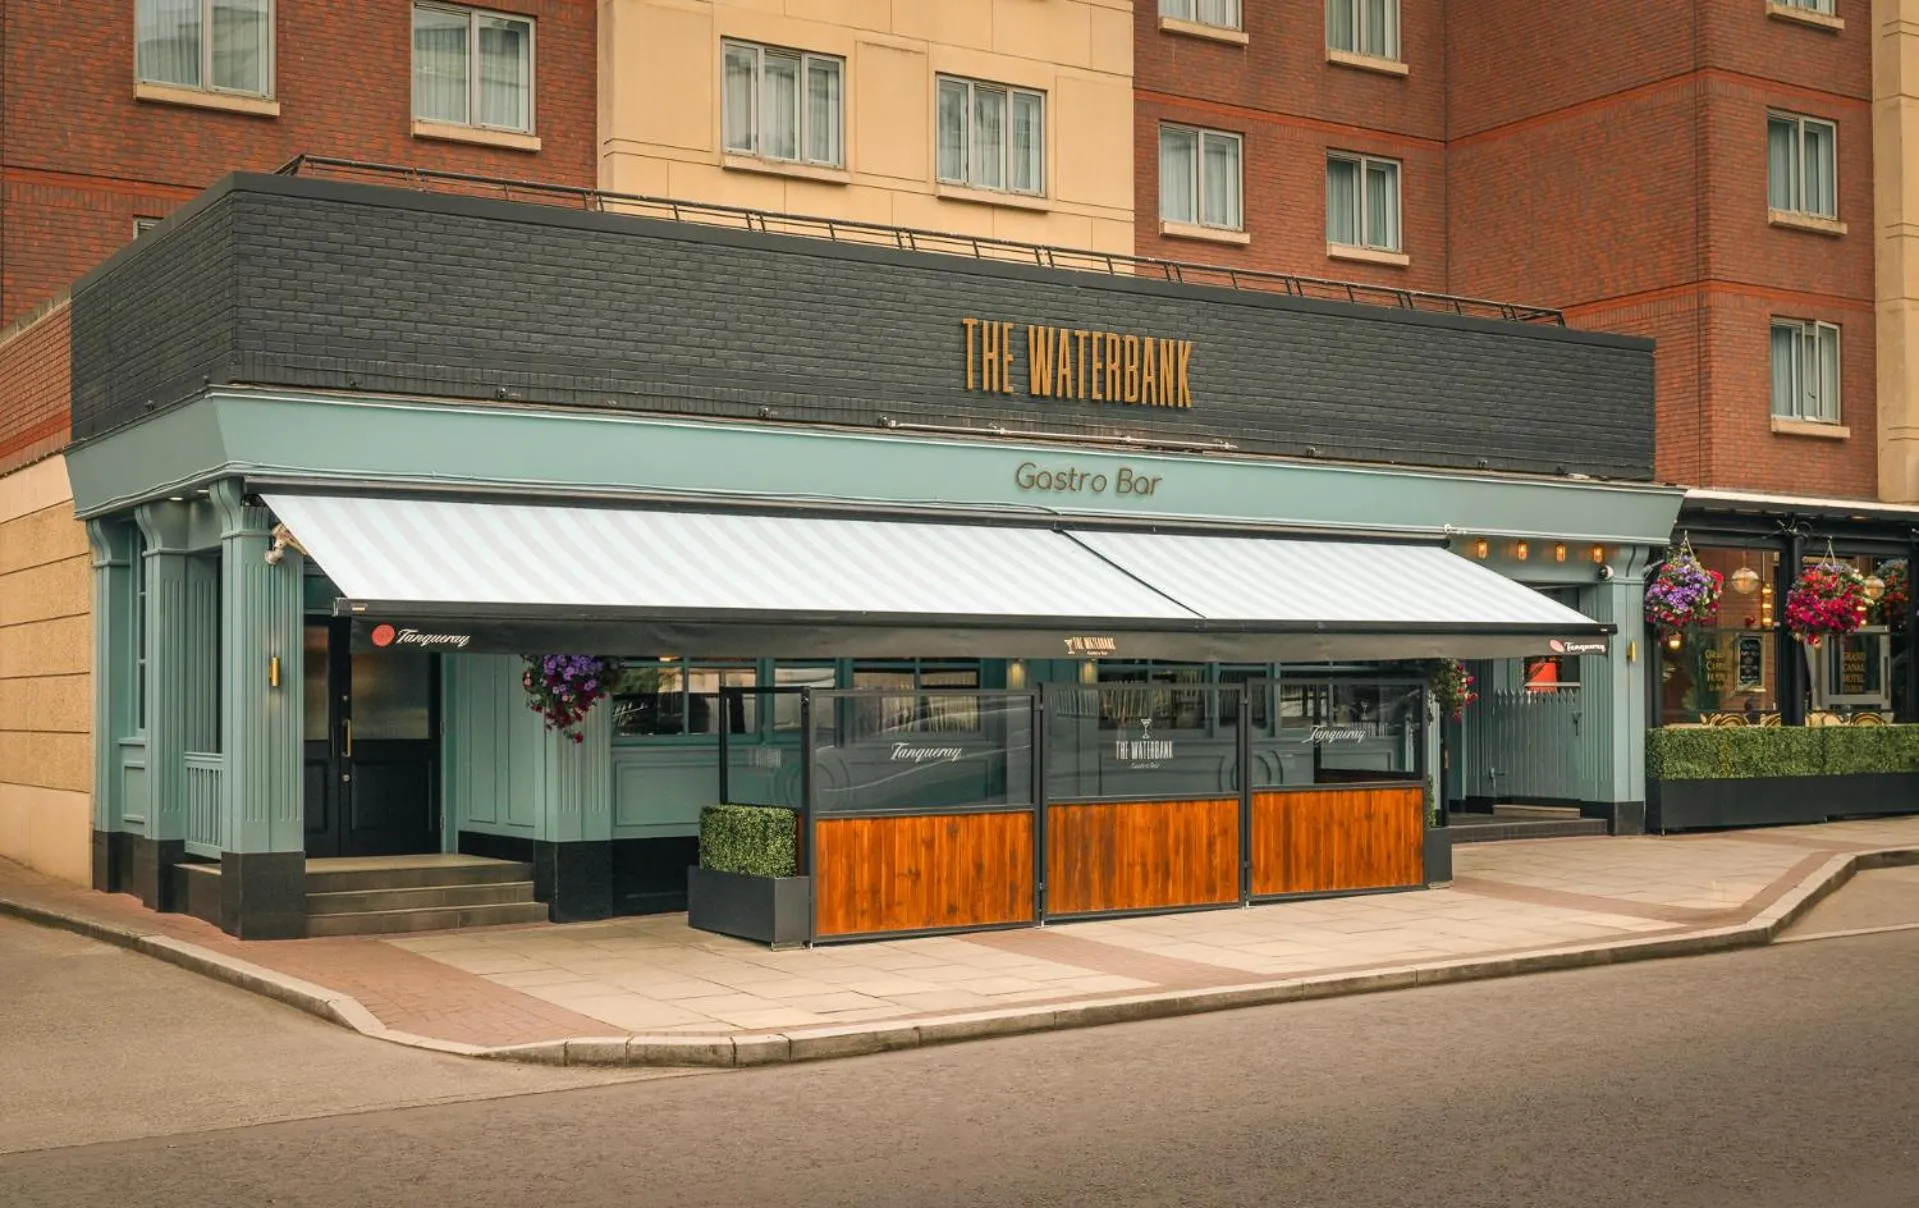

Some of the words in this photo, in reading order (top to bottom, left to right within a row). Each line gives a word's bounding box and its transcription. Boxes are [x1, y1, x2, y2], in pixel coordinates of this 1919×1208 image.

[962, 318, 1015, 394] THE
[1028, 324, 1193, 408] WATERBANK
[1016, 462, 1107, 493] Gastro
[1116, 467, 1162, 495] Bar
[395, 629, 471, 648] Tanqueray
[1301, 724, 1366, 744] Tanqueray
[890, 742, 962, 763] Tanqueray
[1116, 741, 1128, 760] THE
[1131, 741, 1174, 760] WATERBANK
